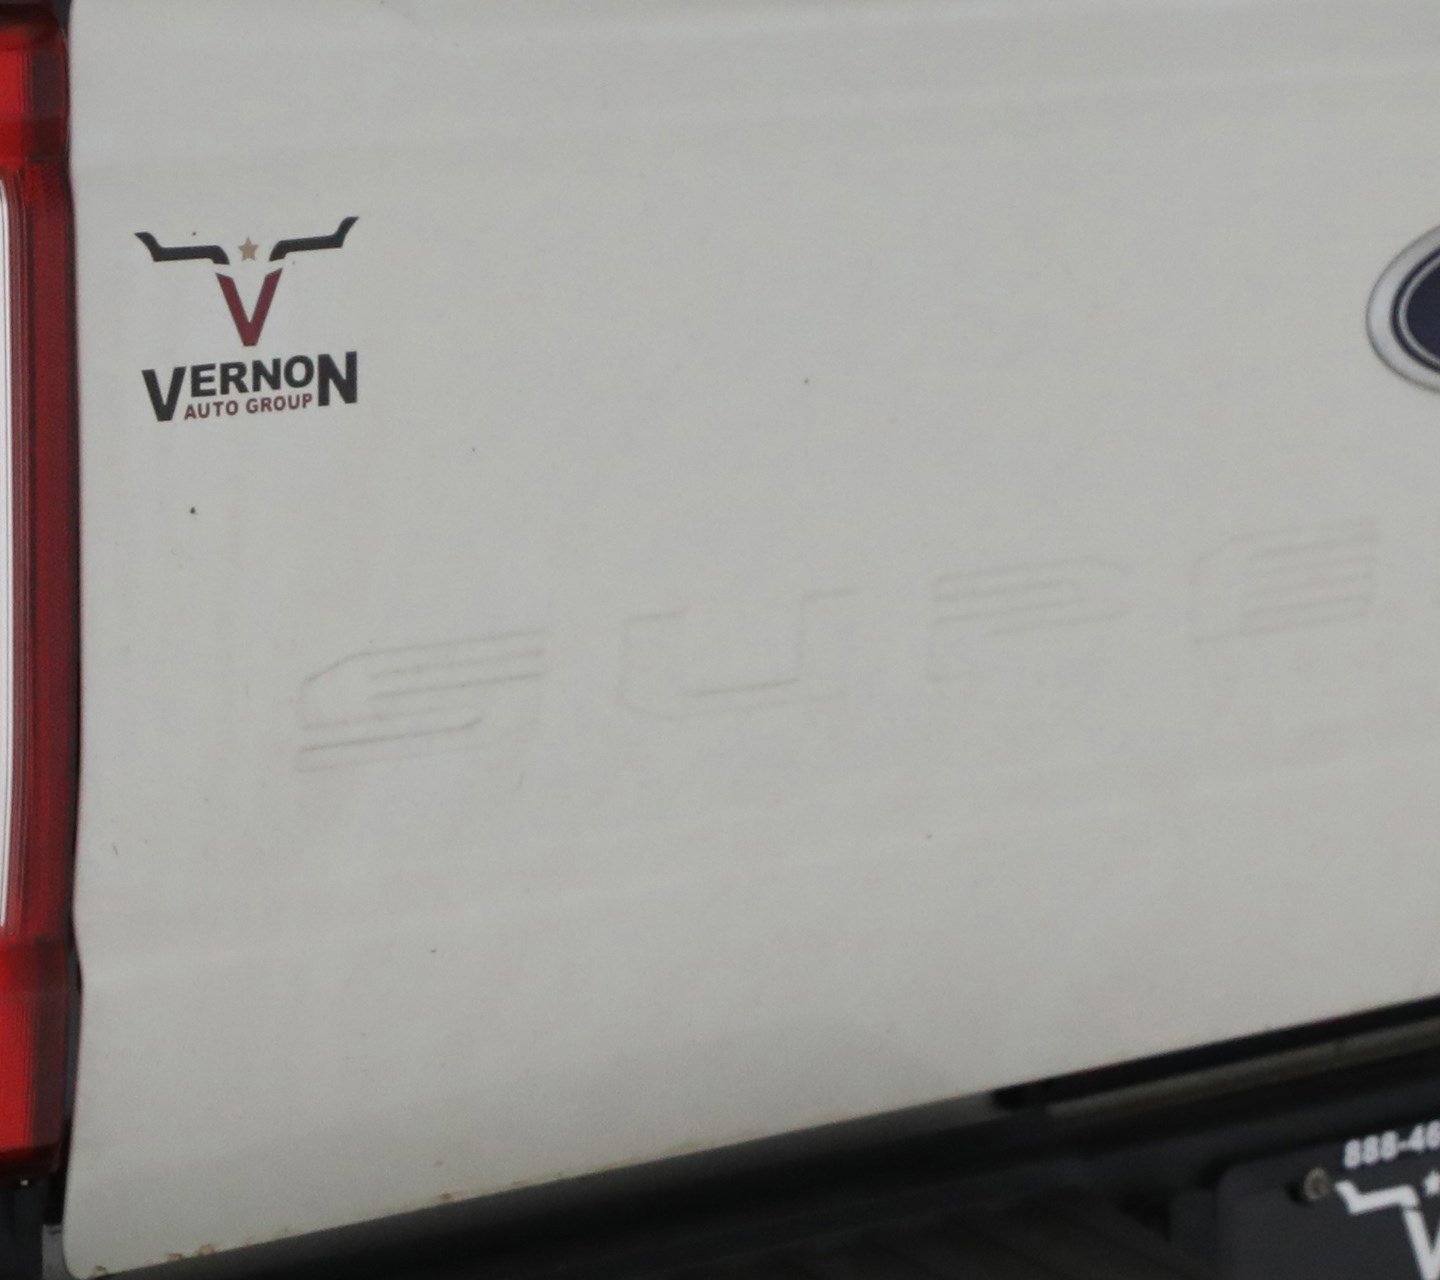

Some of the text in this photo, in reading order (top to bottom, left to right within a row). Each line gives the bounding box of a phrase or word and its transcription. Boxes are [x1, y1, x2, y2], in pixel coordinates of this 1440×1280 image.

[141, 351, 358, 422] VERNON
[184, 392, 313, 421] AUTO GROUP
